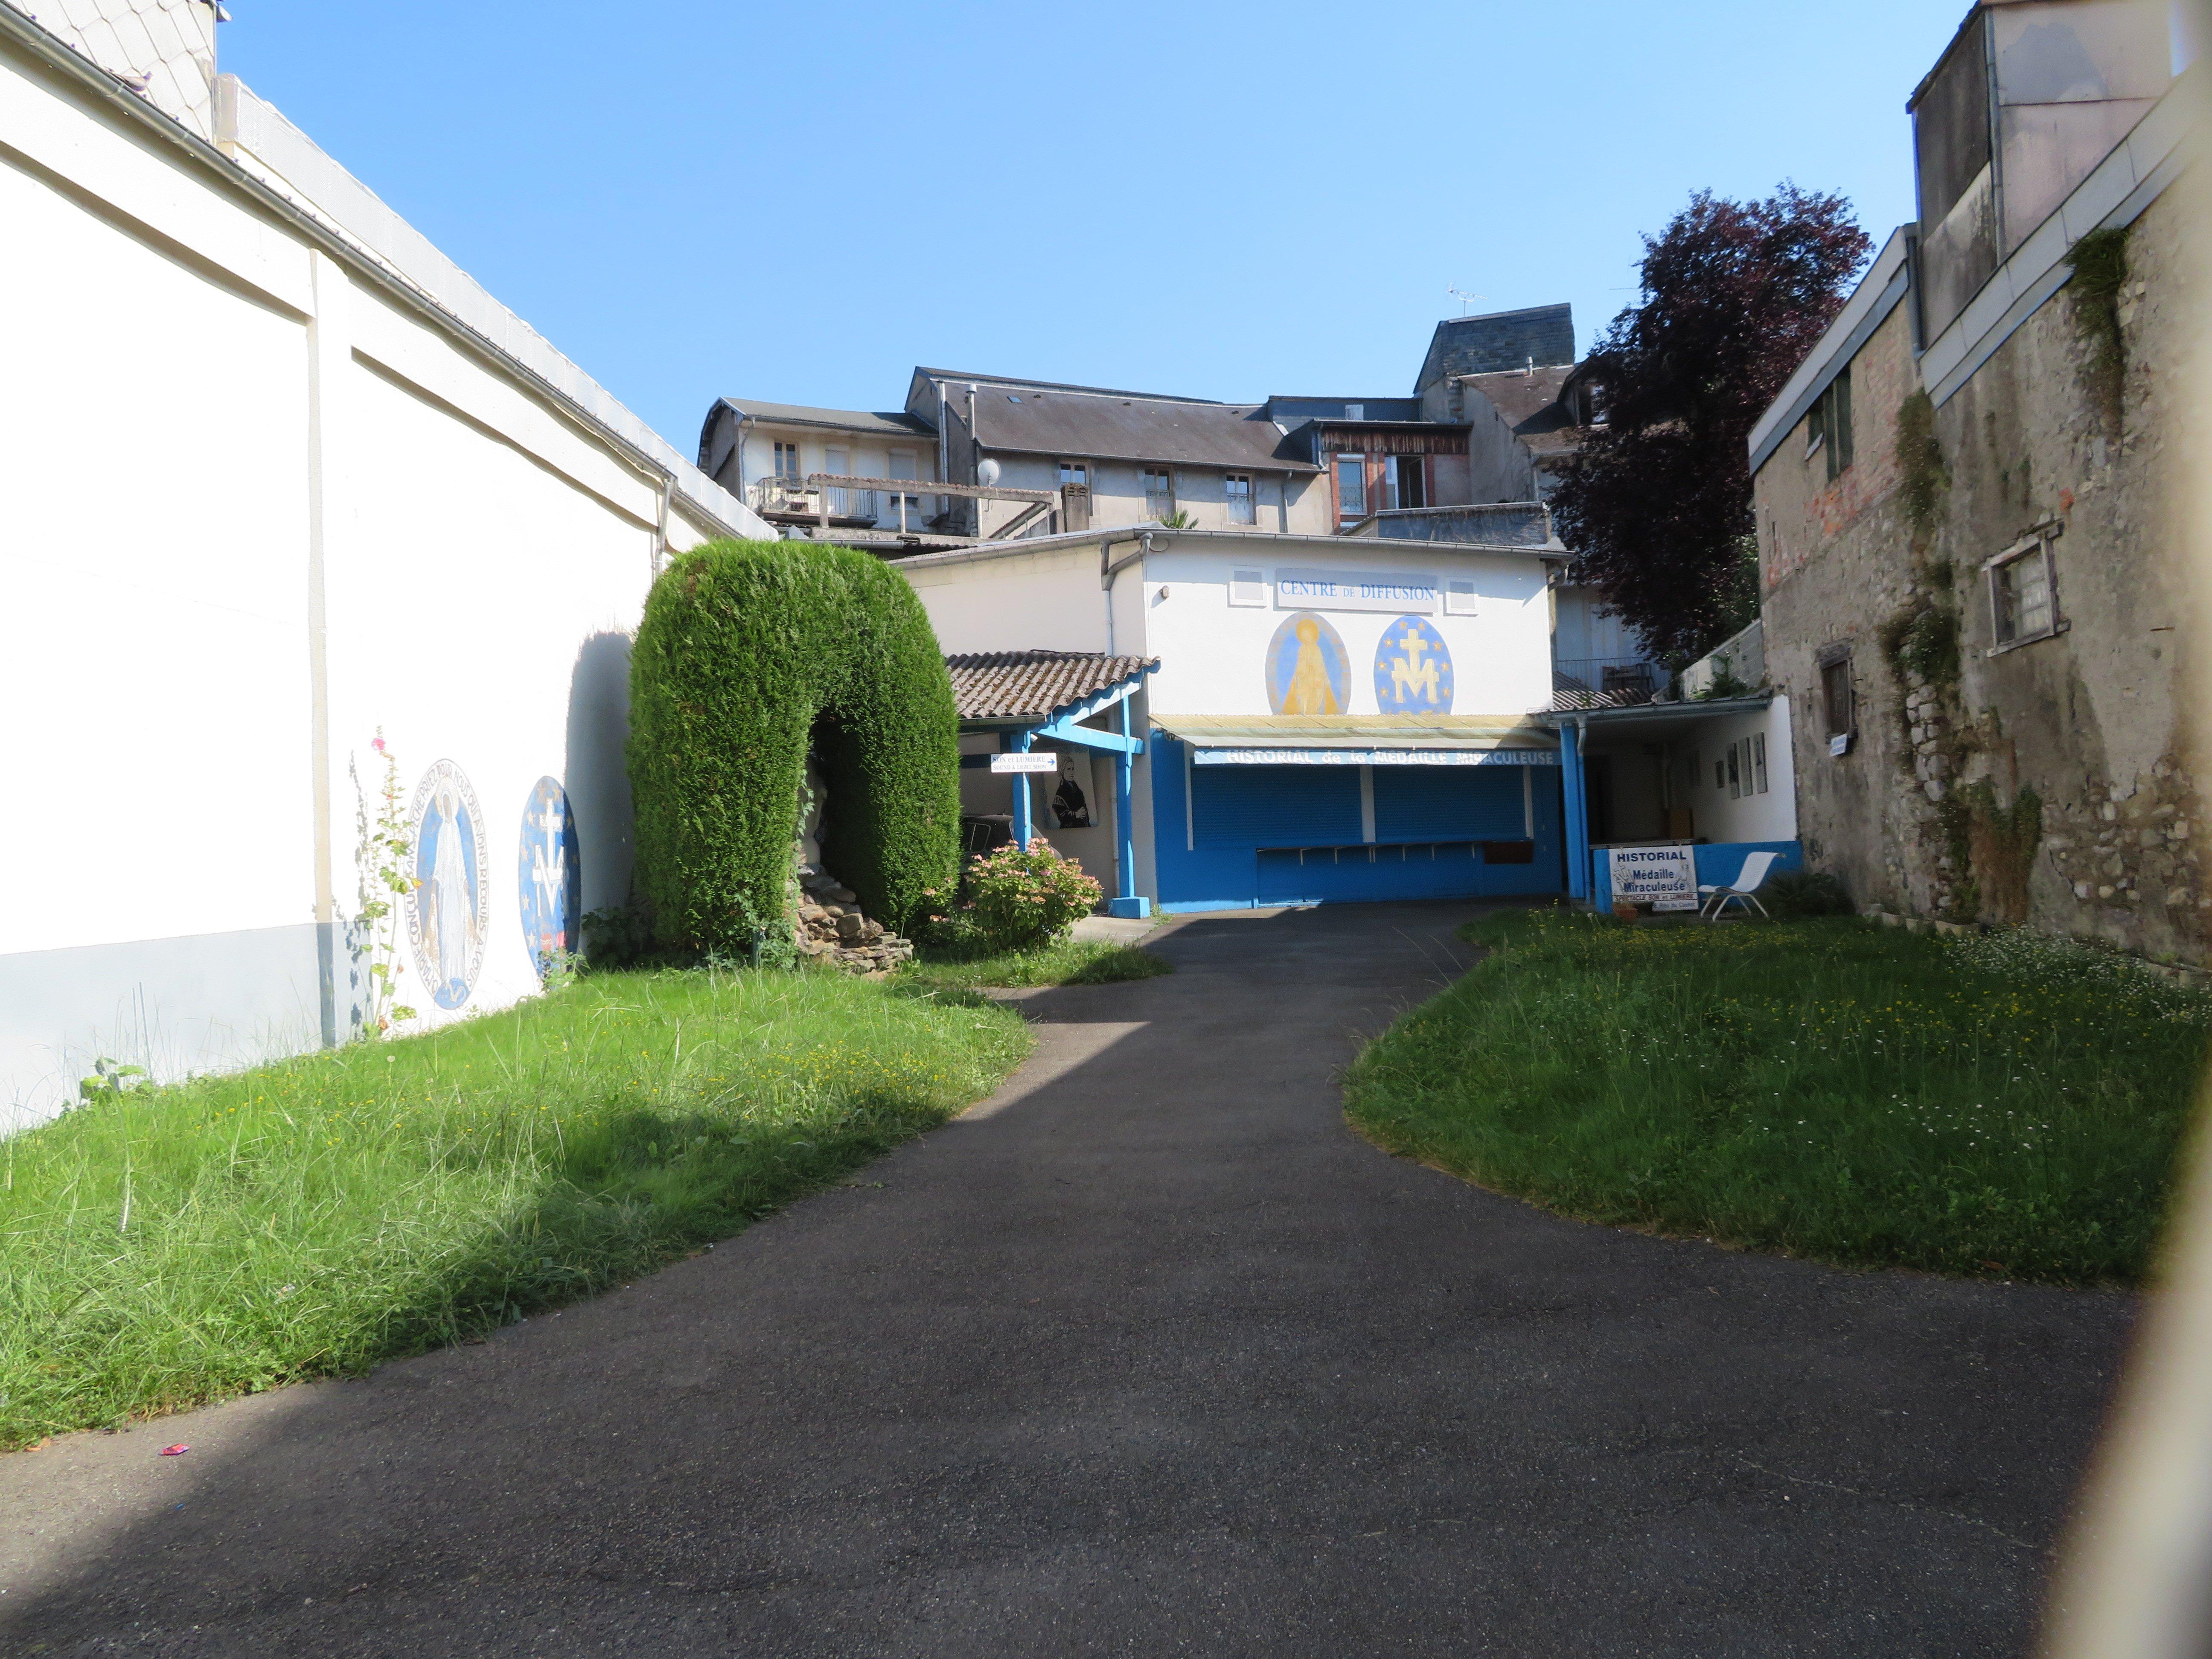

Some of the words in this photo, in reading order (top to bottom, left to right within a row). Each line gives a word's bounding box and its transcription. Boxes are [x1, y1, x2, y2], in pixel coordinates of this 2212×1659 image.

[1281, 580, 1337, 597] CENTRE
[1343, 588, 1355, 597] DE
[1360, 583, 1434, 601] DIFFUSION
[1016, 754, 1046, 763] LUMIÈRE
[1226, 749, 1314, 763] HISTORIAL
[1321, 751, 1341, 763] de
[1350, 751, 1365, 763] la
[1455, 752, 1553, 764] MIRACULEUSE
[473, 819, 487, 866] AVONS
[1617, 851, 1686, 862] HISTORIAL
[1633, 867, 1674, 880] Médaille
[1624, 881, 1685, 893] Miraculeuse
[478, 868, 488, 931] RECOURS
